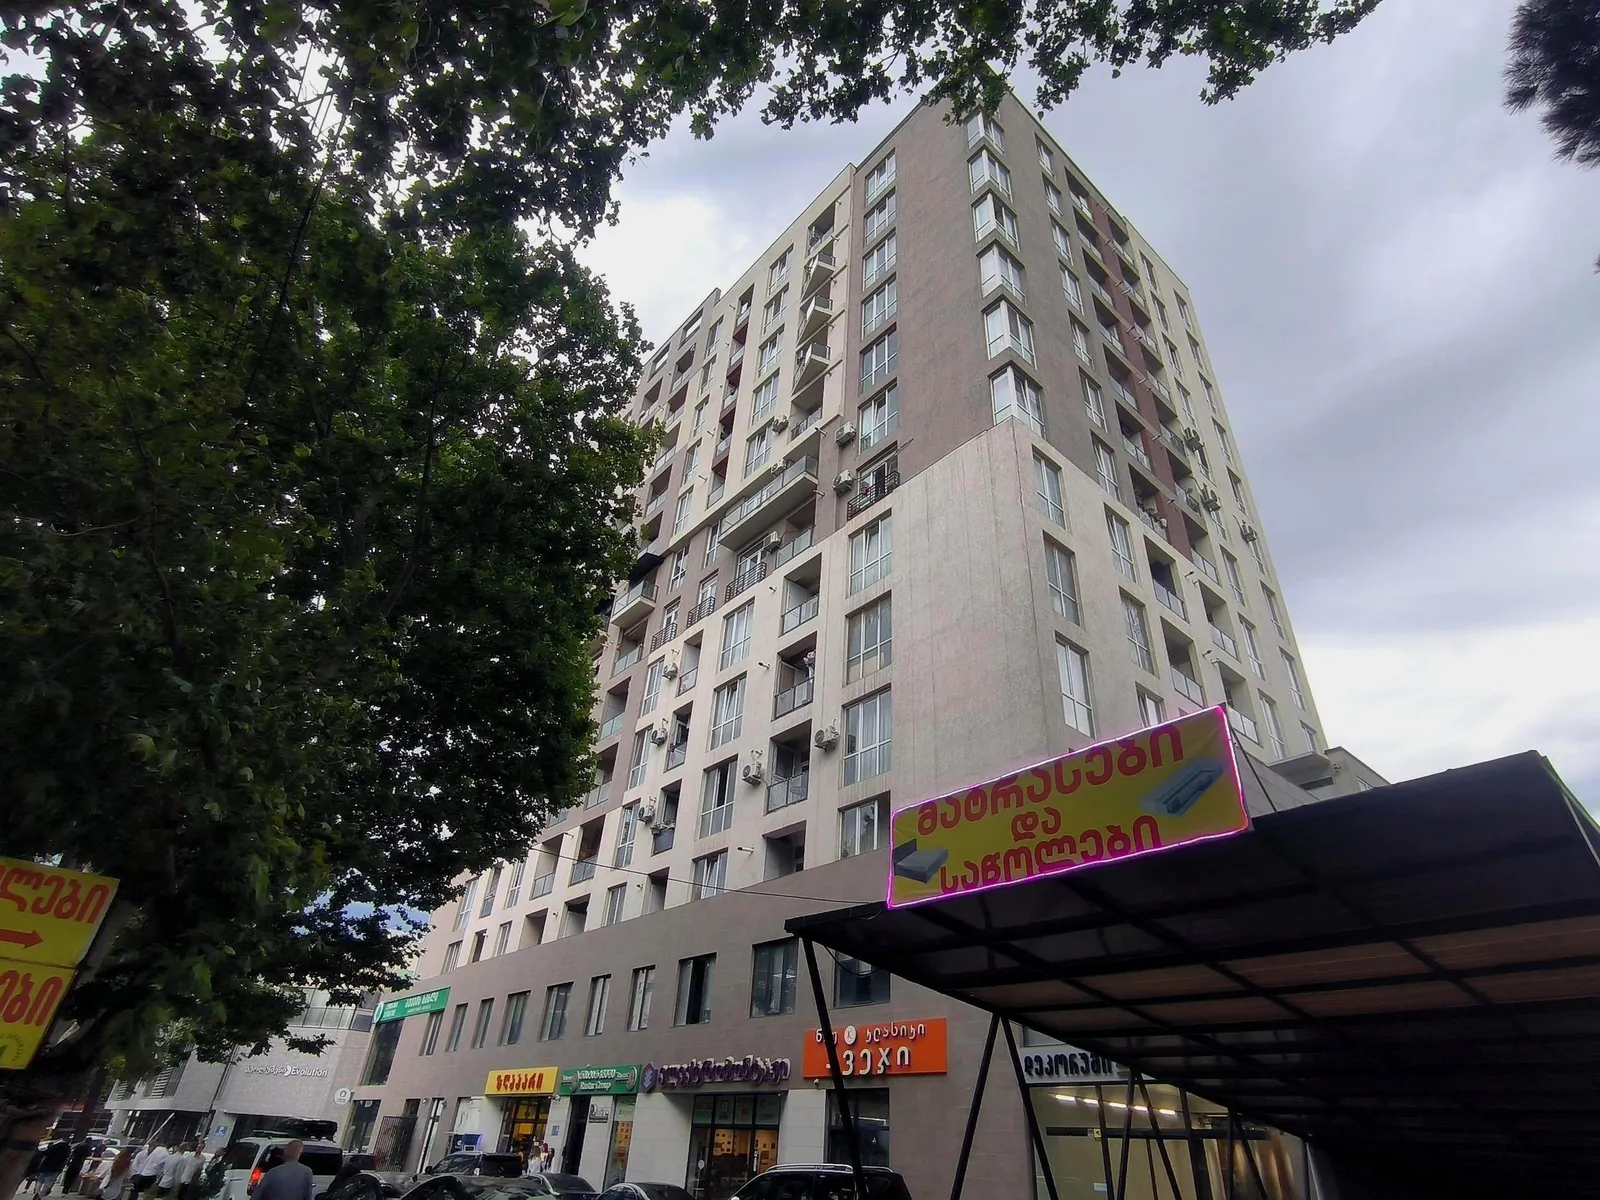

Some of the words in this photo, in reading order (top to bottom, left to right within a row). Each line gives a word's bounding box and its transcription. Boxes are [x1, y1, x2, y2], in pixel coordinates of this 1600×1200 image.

[917, 725, 1184, 836] მატრასები
[1011, 807, 1061, 842] და
[939, 815, 1161, 894] საწოლები
[0, 864, 110, 924] ლები
[815, 1028, 838, 1045] ნუ
[290, 1065, 329, 1078] Evolution
[826, 1045, 909, 1075] ვეჯი
